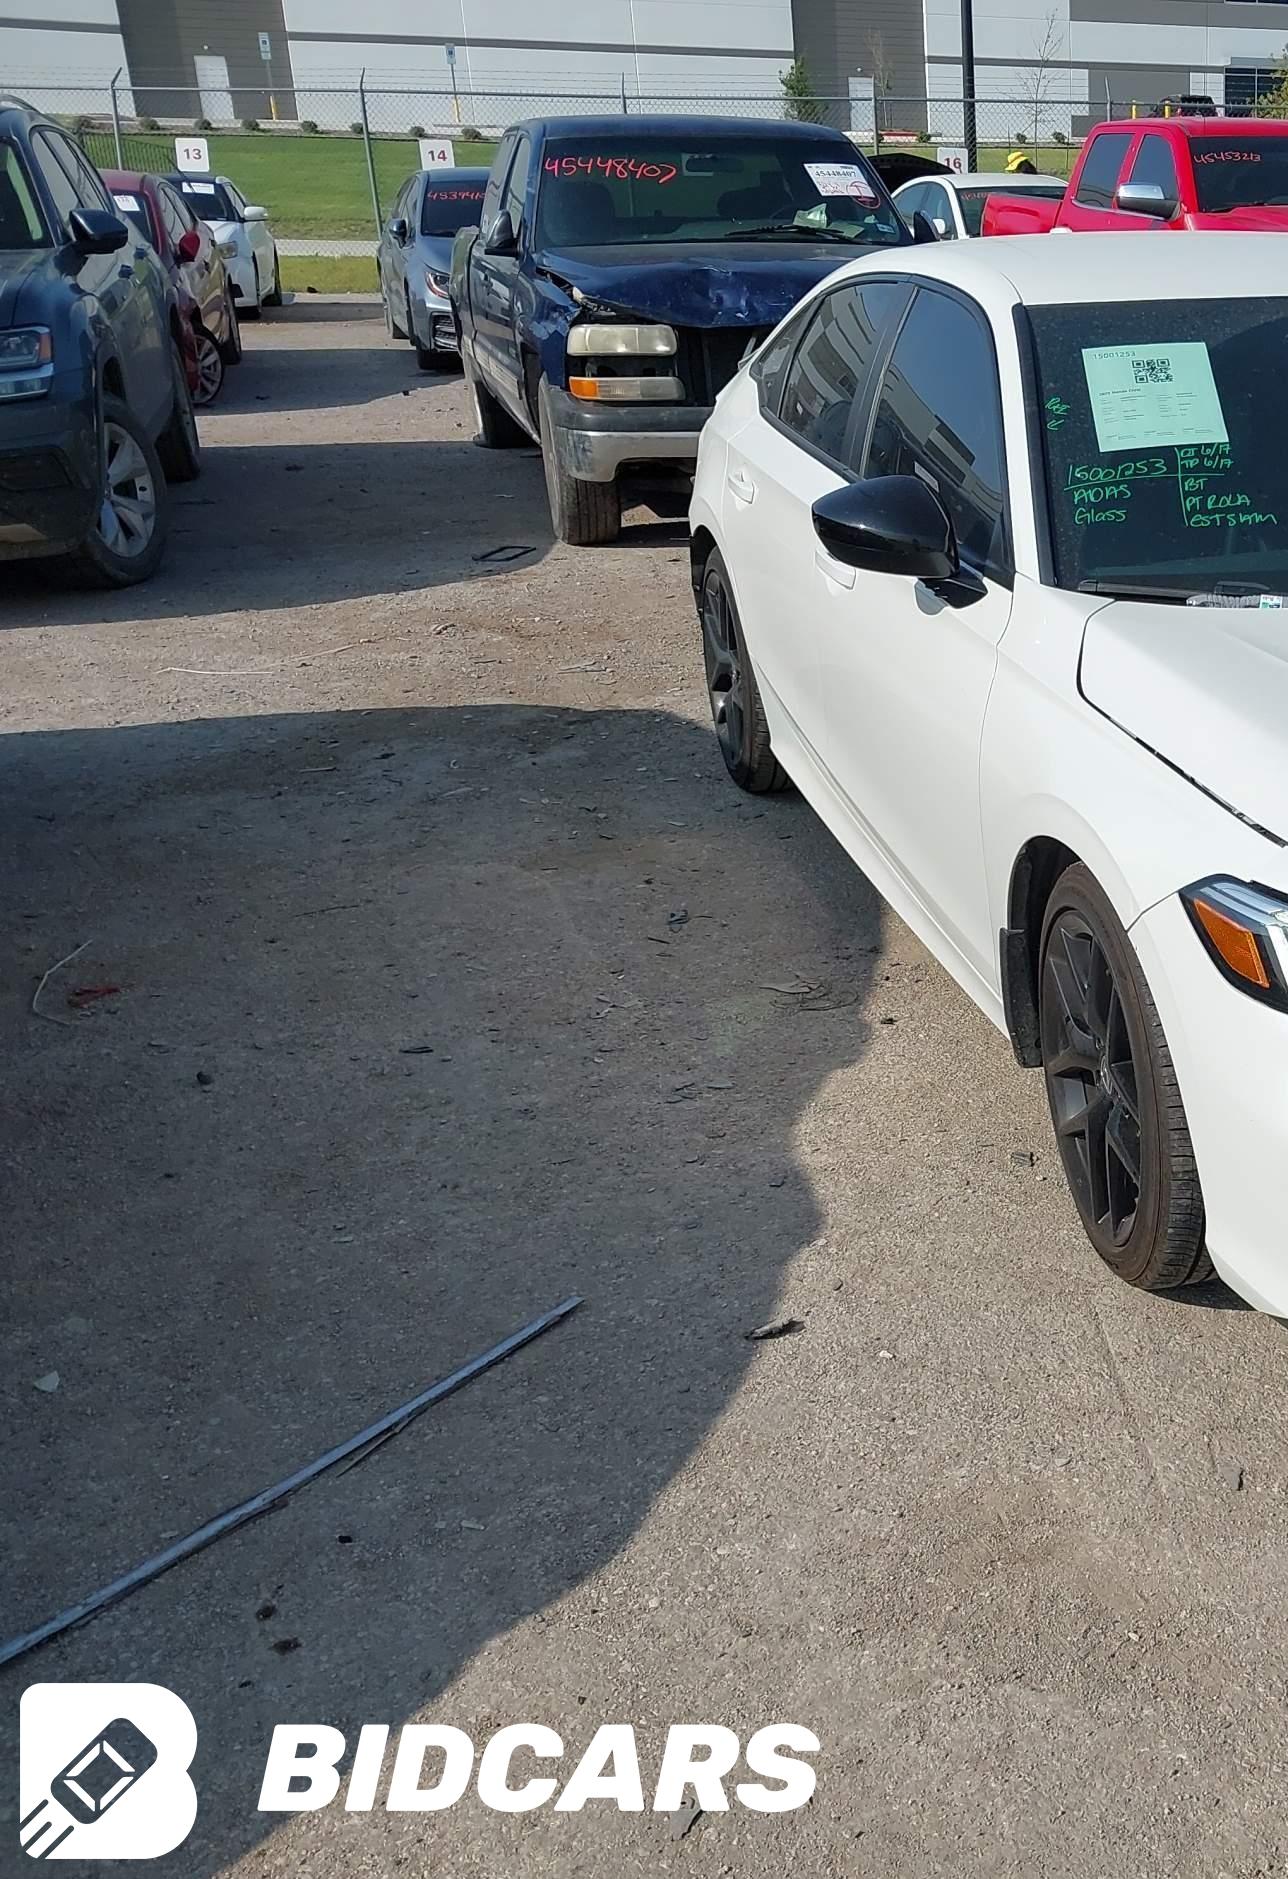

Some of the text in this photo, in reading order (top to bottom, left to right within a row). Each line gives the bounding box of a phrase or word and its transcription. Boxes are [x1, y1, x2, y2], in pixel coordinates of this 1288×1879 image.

[183, 148, 203, 160] 13
[427, 149, 448, 162] 14
[1193, 151, 1261, 164] 45453213
[544, 156, 677, 184] 45448407
[943, 157, 962, 170] 16
[1068, 458, 1168, 486] 15001253
[1074, 507, 1128, 525] Glass
